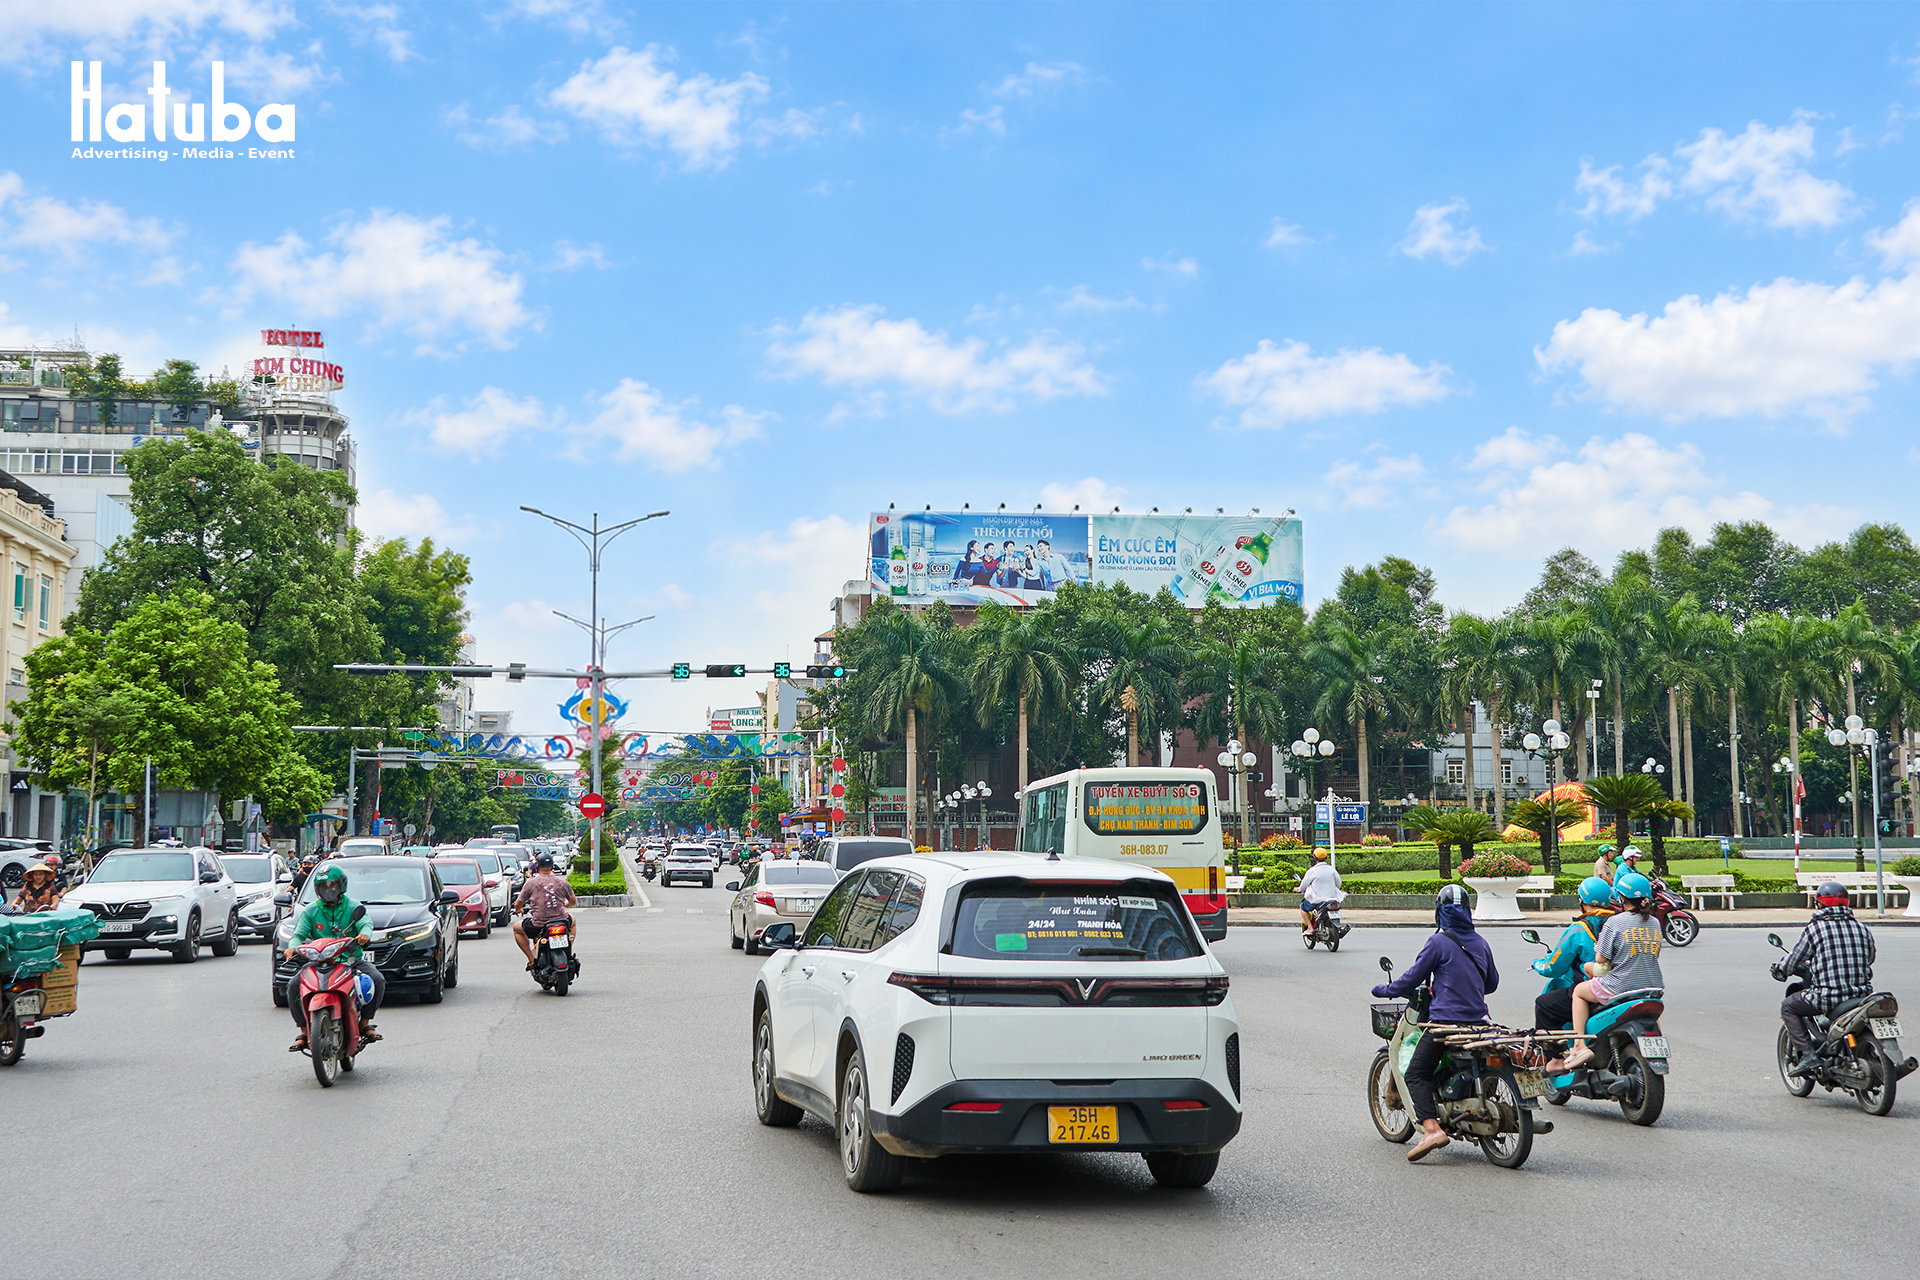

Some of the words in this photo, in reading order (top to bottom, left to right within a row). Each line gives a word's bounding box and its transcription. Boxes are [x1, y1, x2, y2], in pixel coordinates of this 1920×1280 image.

[254, 358, 284, 374] KIM
[973, 525, 1005, 538] THÊM
[1008, 525, 1030, 538] KẾT
[1032, 525, 1053, 538] NỐI
[1099, 535, 1120, 552] ÊM
[1124, 538, 1151, 554] CỰC
[1155, 536, 1176, 553] ÊM
[1099, 553, 1125, 564] XỨNG
[1128, 556, 1156, 564] MONG
[1159, 556, 1175, 566] ĐỢI
[1190, 569, 1211, 587] PILSNER
[1224, 569, 1247, 589] PILSNER
[1259, 584, 1274, 594] BIA
[675, 664, 688, 677] 36
[776, 664, 790, 677] 36
[1092, 783, 1124, 798] TUYẾN
[1127, 787, 1139, 798] XE
[1143, 784, 1168, 798] BUÝT
[1172, 784, 1186, 798] SỐ
[1190, 787, 1197, 797] 5
[1146, 806, 1154, 815] BV
[1157, 805, 1166, 815] ĐA
[1168, 805, 1187, 814] KHOA
[1100, 820, 1115, 832] CHỢ
[1117, 820, 1133, 829] NAM
[1134, 817, 1158, 829] THÀNH
[1179, 819, 1193, 829] SƠN
[1120, 845, 1168, 855] 36H-083.07
[1073, 895, 1097, 905] NHÍM
[1099, 895, 1118, 905] SÓC
[1028, 920, 1055, 928] 24/24
[1105, 920, 1122, 929] HÓA
[1069, 1108, 1097, 1123] 36H
[1057, 1126, 1110, 1140] 217.46
